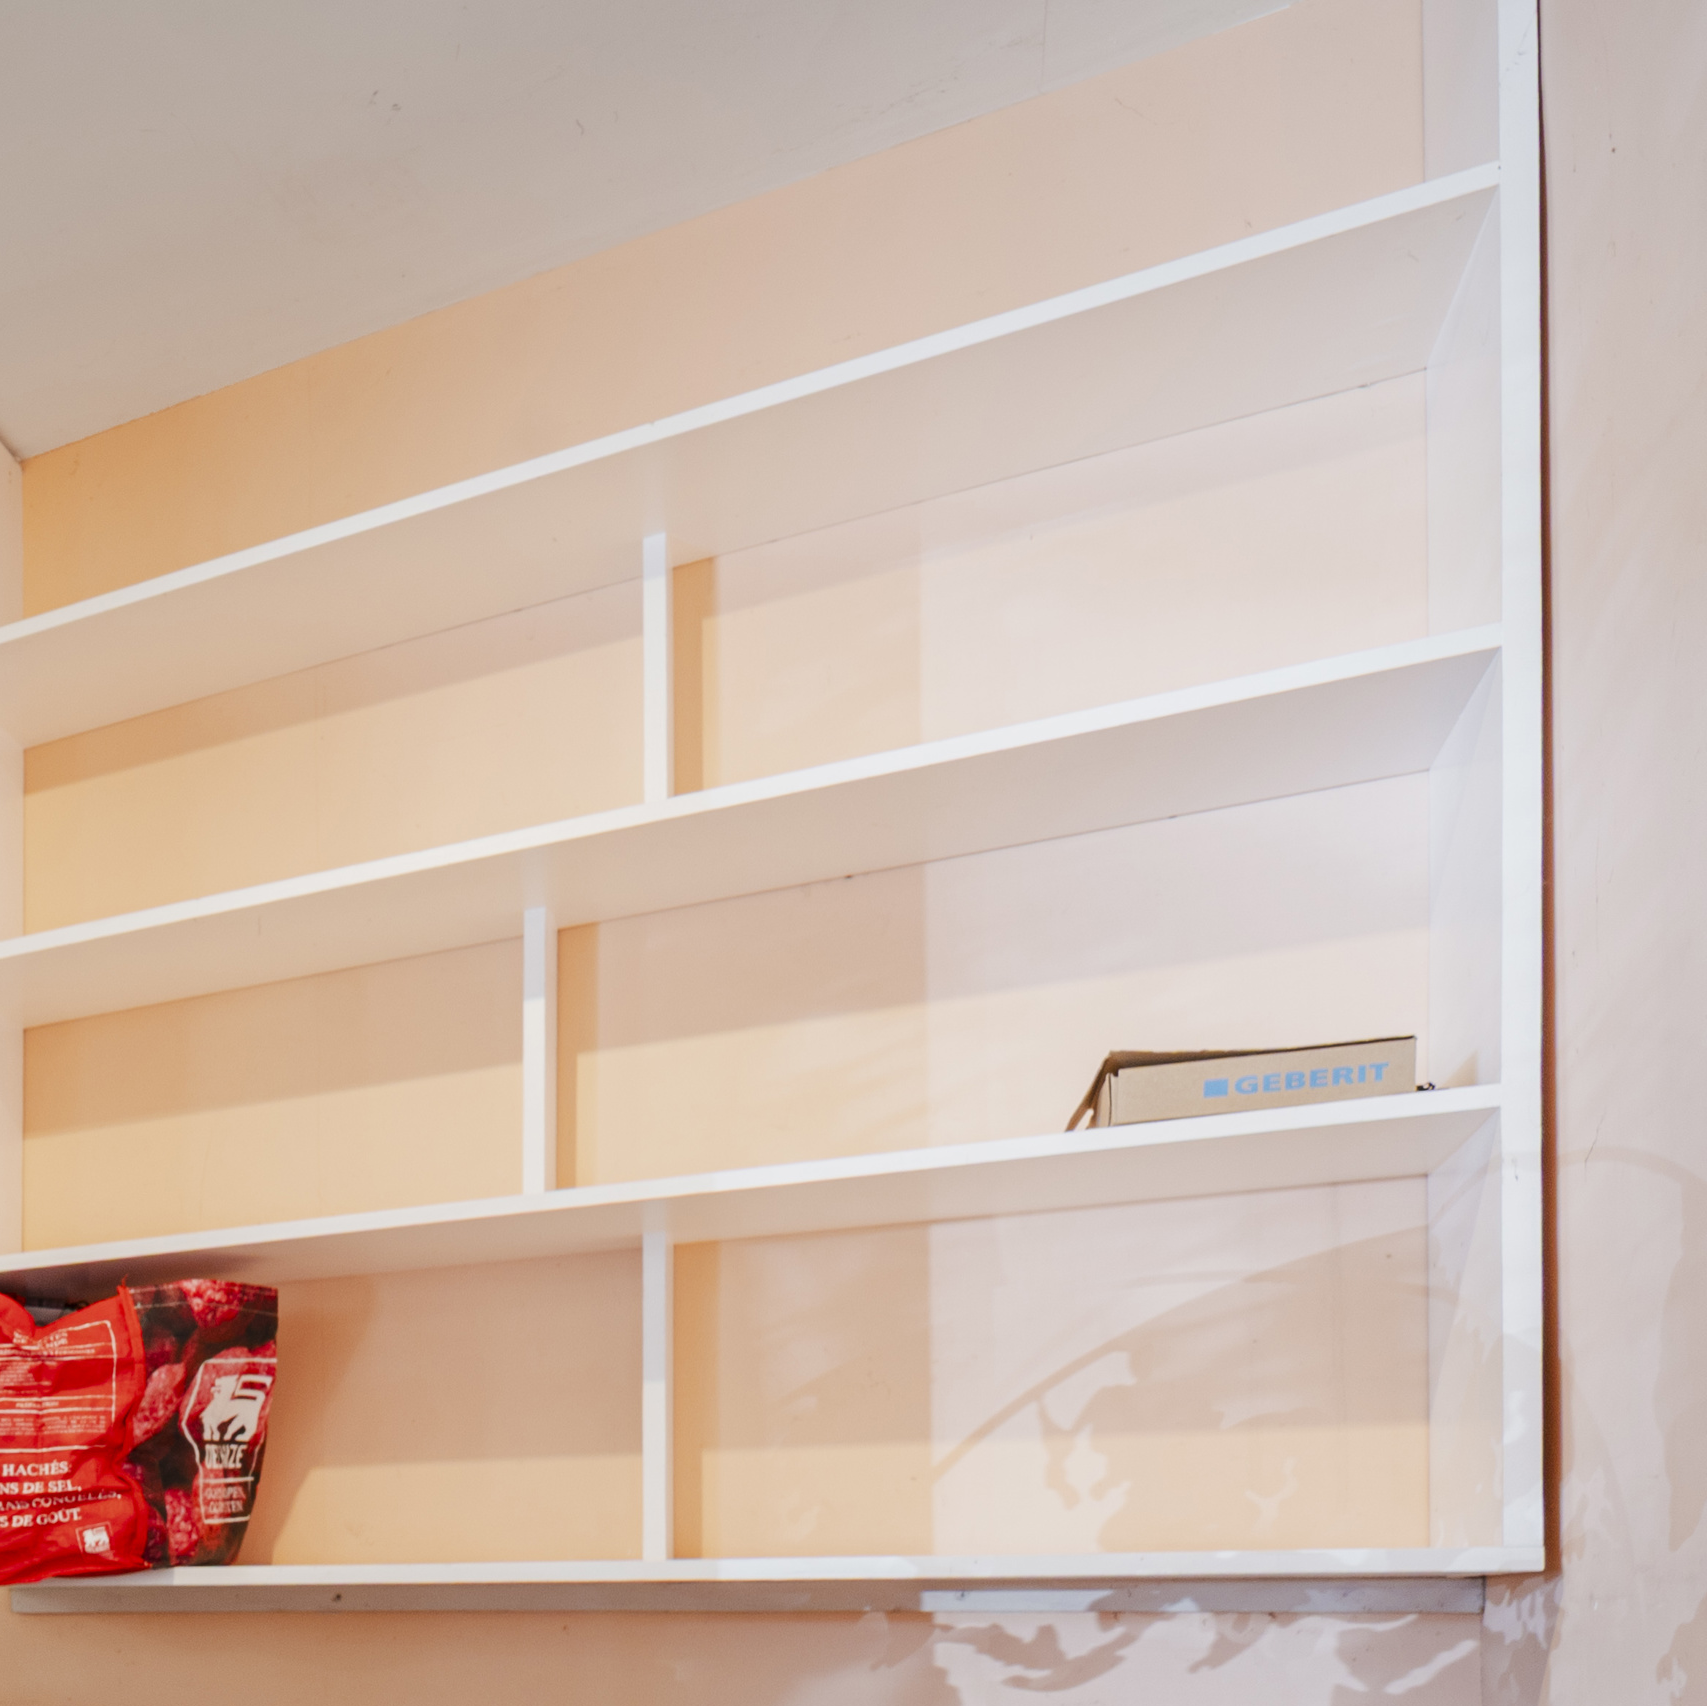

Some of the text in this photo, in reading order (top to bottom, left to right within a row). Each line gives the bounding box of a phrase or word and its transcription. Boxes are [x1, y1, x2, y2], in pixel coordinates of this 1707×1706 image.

[1234, 1062, 1390, 1096] GEBERIT
[22, 1481, 45, 1495] DE
[47, 1479, 83, 1493] SEL,
[11, 1513, 34, 1528] DE
